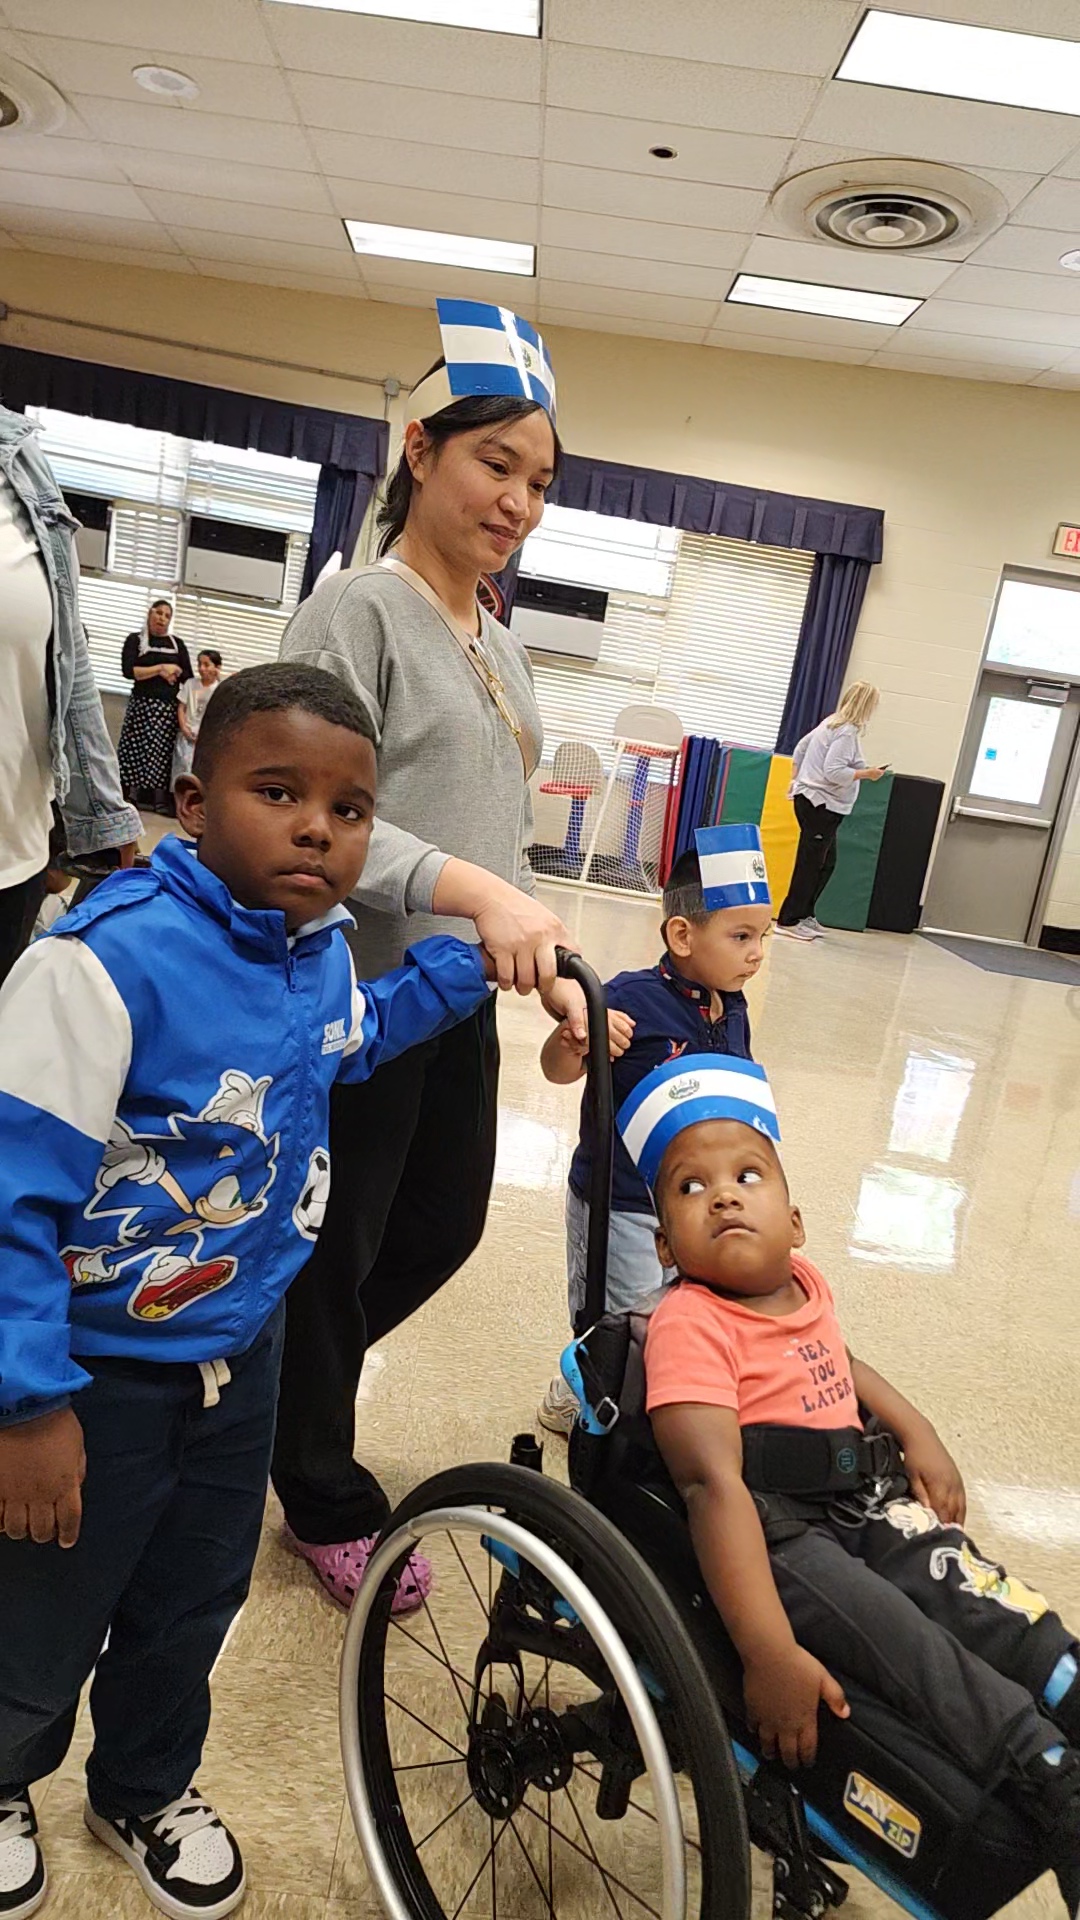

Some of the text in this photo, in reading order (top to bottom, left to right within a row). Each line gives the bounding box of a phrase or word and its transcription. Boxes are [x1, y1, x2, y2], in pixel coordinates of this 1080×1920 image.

[798, 1339, 830, 1362] SEA
[808, 1359, 836, 1386] YOU
[801, 1377, 852, 1413] LATER
[849, 1778, 896, 1822] JAY
